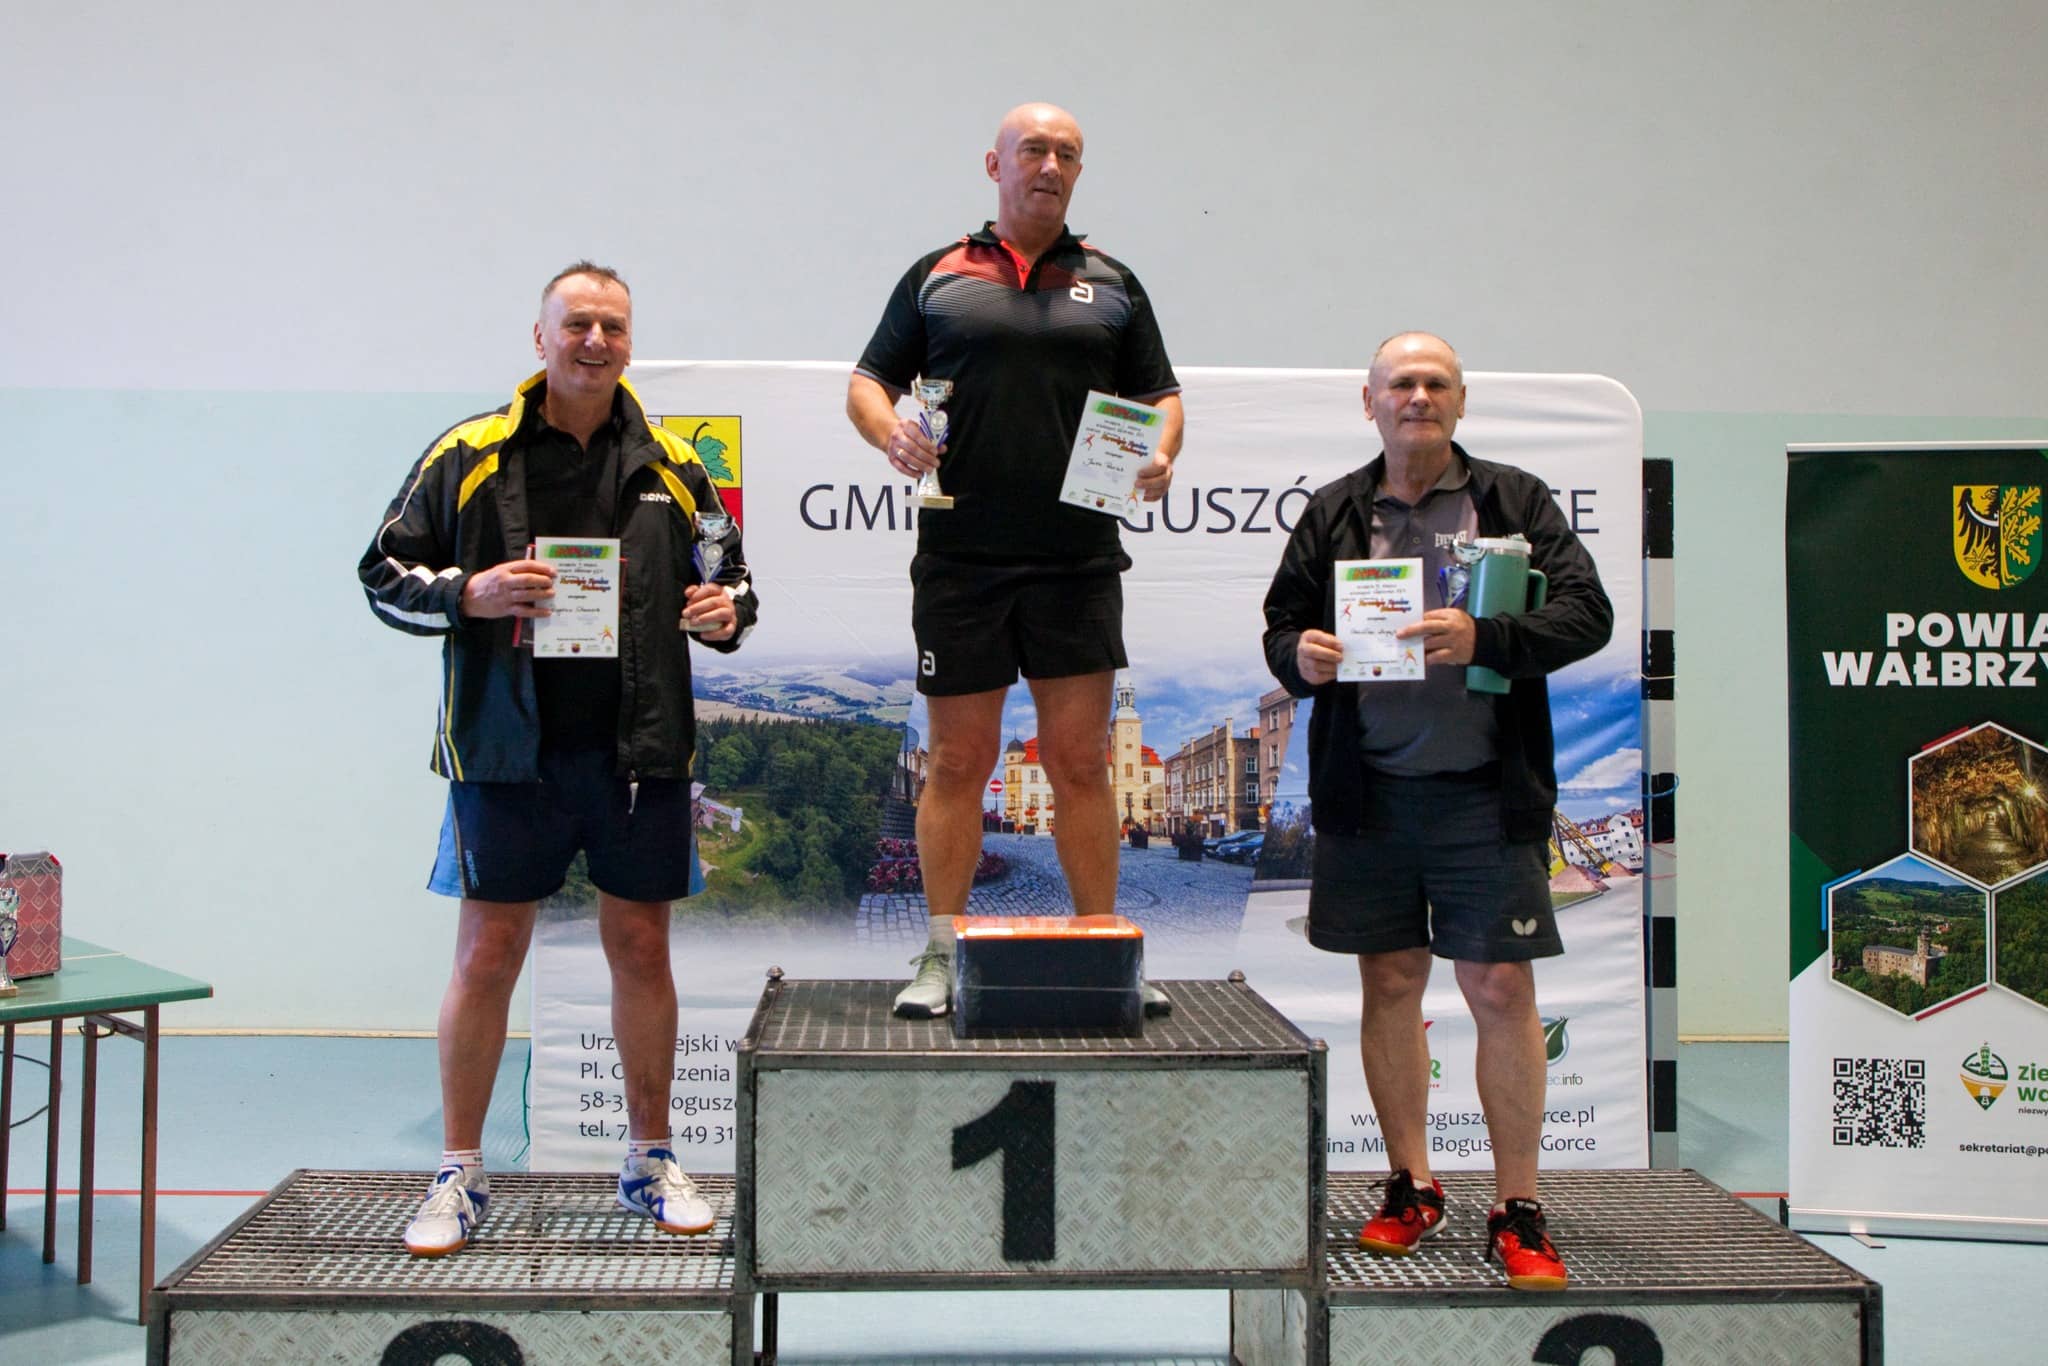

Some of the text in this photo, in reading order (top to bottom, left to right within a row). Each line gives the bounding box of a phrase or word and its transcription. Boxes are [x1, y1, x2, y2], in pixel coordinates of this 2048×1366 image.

[800, 484, 913, 531] GMI
[1822, 652, 2048, 687] WAŁBRZ
[581, 1033, 615, 1050] Urz
[675, 1033, 719, 1056] ejski
[581, 1061, 603, 1079] Pl.
[580, 1091, 737, 1116] 58-3 ogusz
[579, 1119, 610, 1137] tel.
[617, 1124, 628, 1141] 7
[681, 1126, 707, 1144] 49
[713, 1126, 737, 1144] 31
[1327, 1137, 1355, 1153] ina
[952, 1080, 1056, 1262] 1
